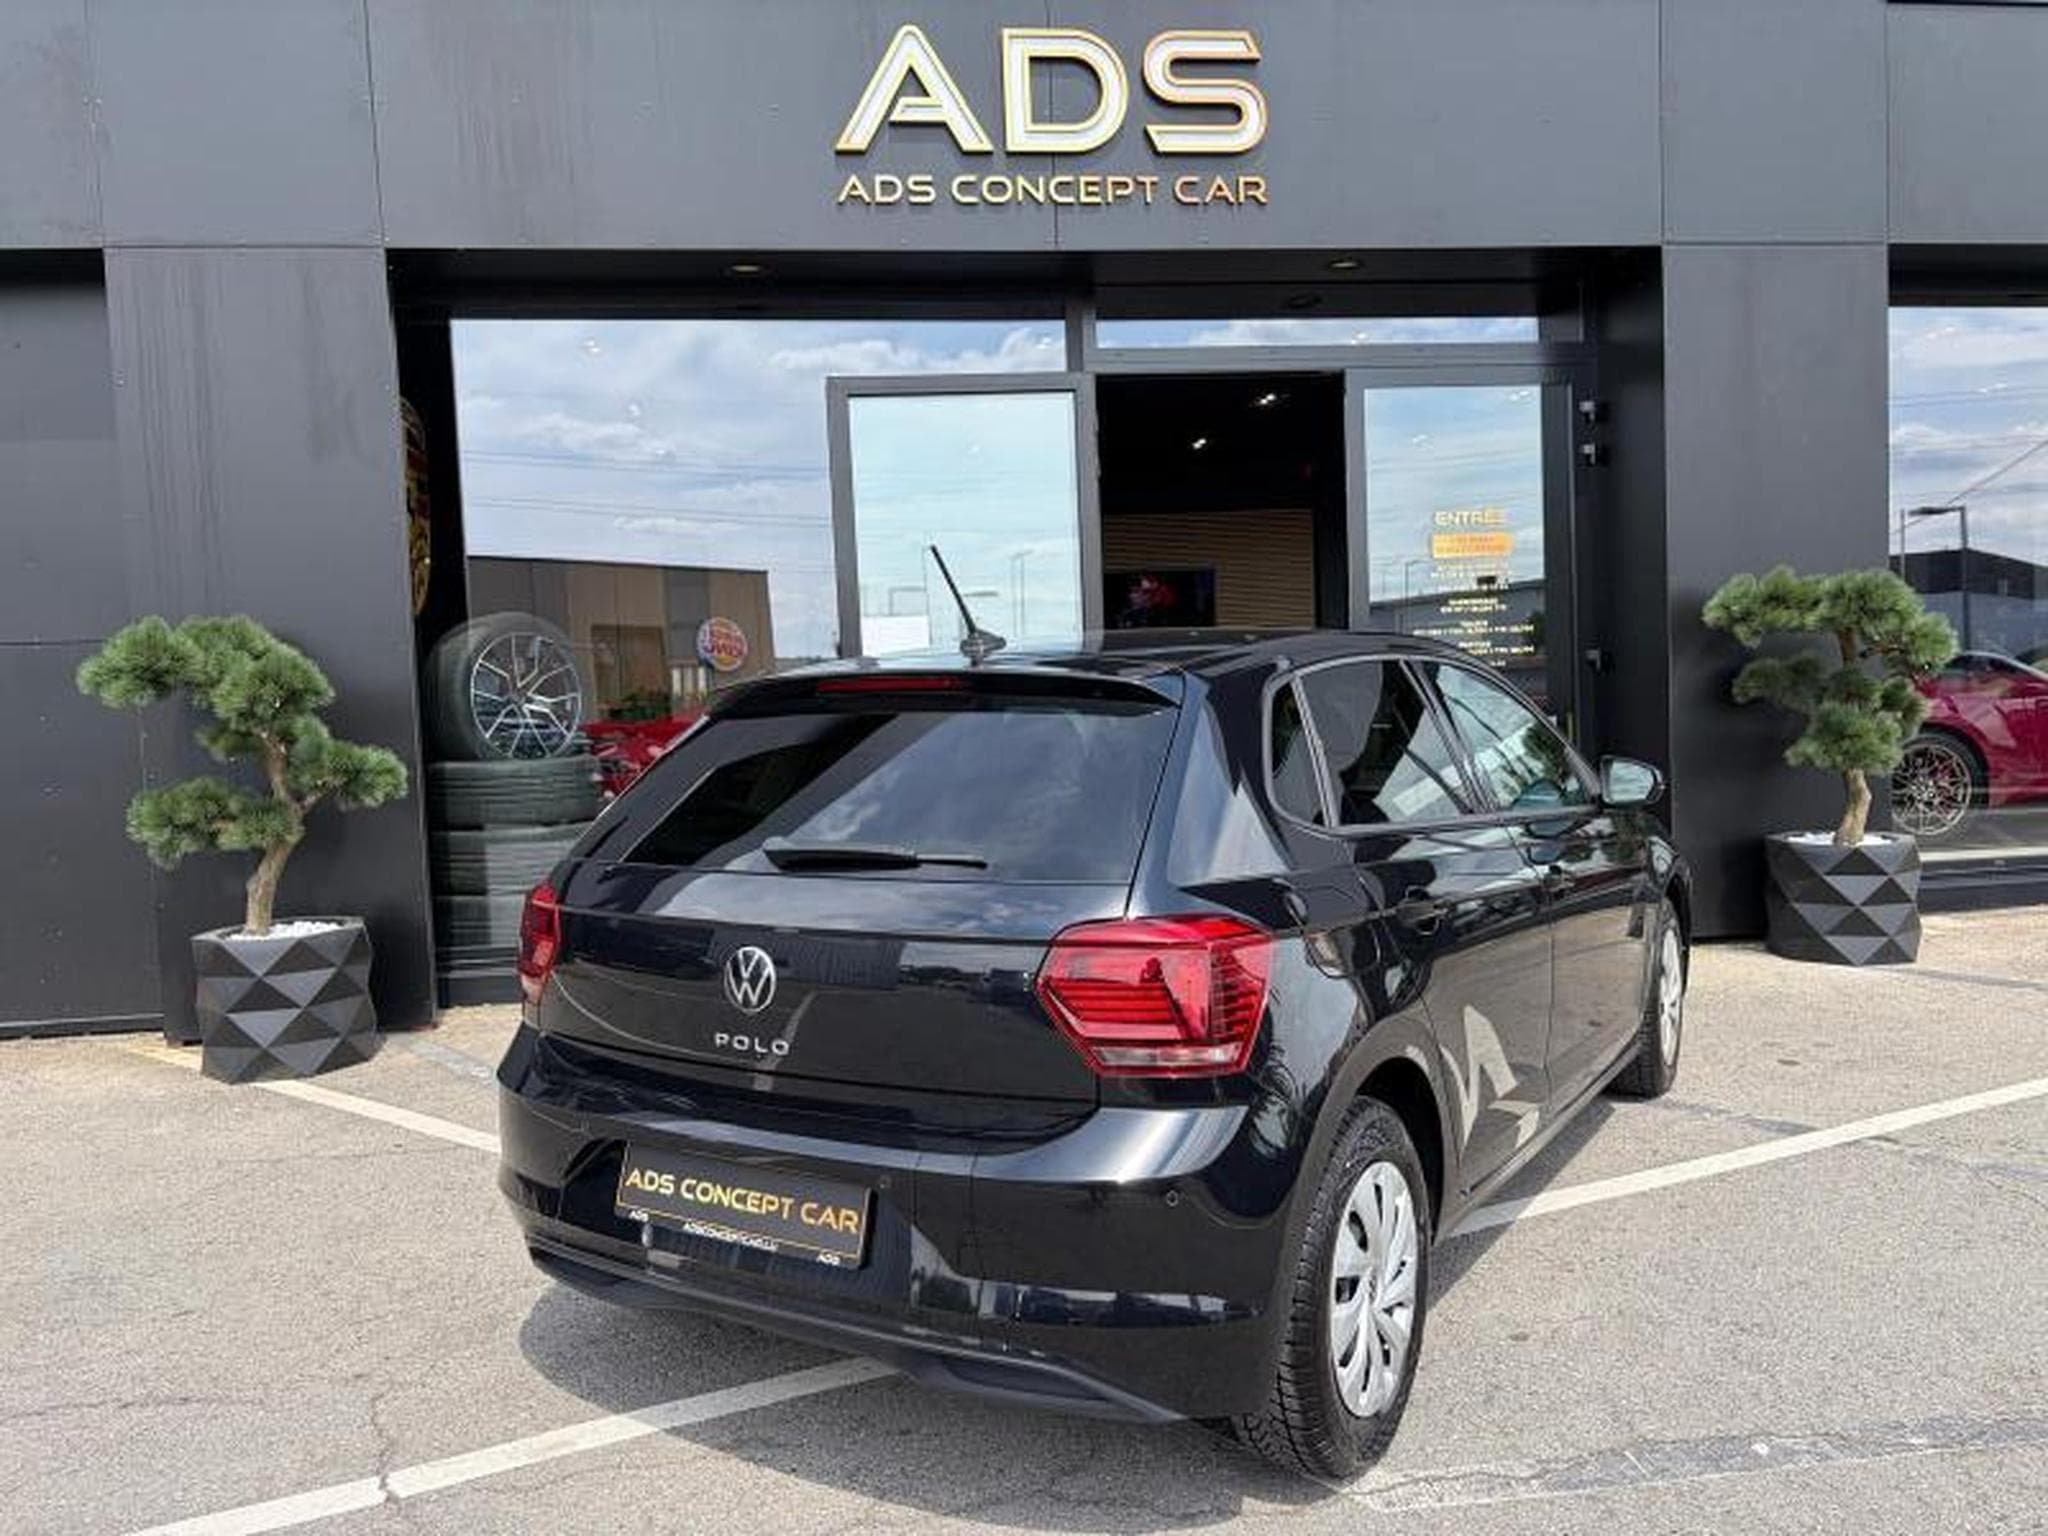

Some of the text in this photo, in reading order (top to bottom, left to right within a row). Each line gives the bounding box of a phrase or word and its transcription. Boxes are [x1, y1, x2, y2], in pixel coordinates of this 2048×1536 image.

[835, 24, 1268, 154] ADS
[838, 174, 1268, 205] ADS CONCEPT CAR
[715, 1032, 789, 1056] POLO
[625, 1167, 859, 1234] ADS CONCEPT CAR
